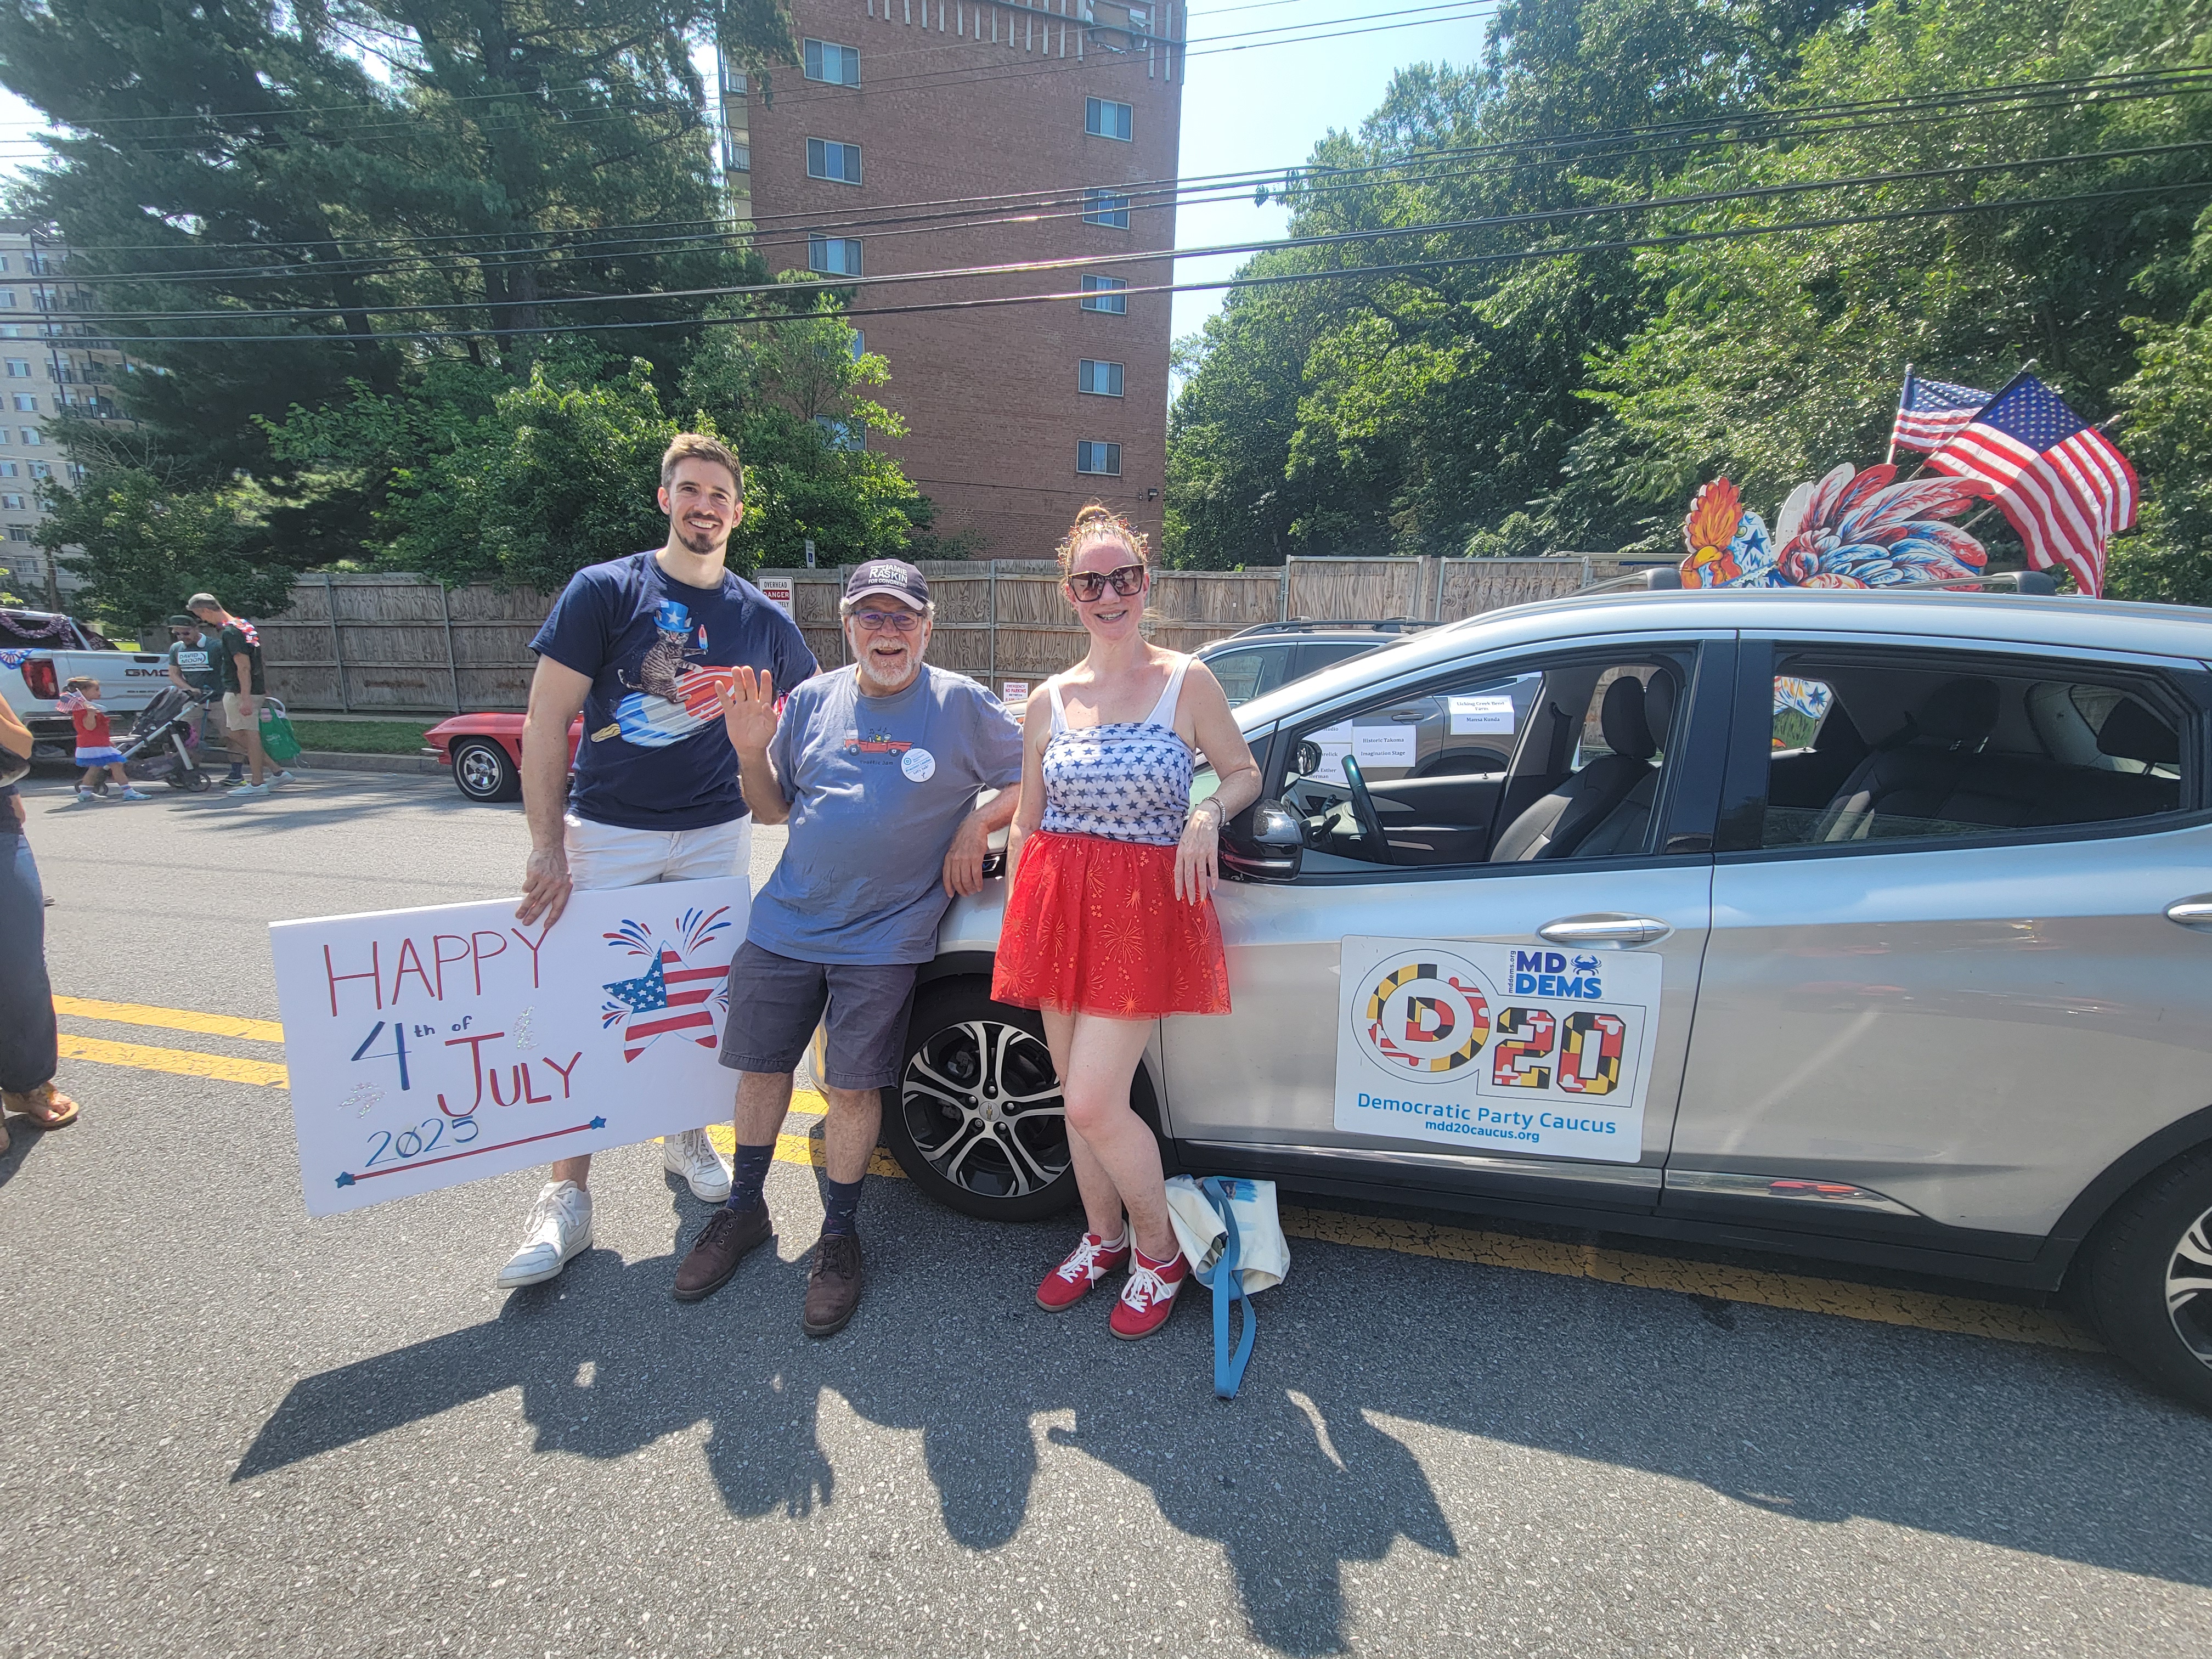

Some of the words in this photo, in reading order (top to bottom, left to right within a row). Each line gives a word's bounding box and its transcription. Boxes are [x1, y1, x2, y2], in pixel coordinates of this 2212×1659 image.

[869, 568, 908, 584] RASKIN
[878, 578, 907, 589] CONGRESS!
[882, 564, 907, 576] JAMIE
[125, 668, 169, 676] GMC
[324, 928, 549, 1017] HAPPY
[1508, 950, 1516, 994] mddems.org
[1516, 951, 1567, 974] MD
[1515, 973, 1602, 1000] DEMS
[351, 1021, 436, 1091] 4th
[452, 1015, 472, 1032] of
[1492, 1007, 1627, 1096] 20
[437, 1032, 583, 1118] JULY
[1357, 1093, 1471, 1120] Democratic
[1478, 1108, 1534, 1131] Party
[1539, 1113, 1617, 1135] Caucus
[365, 1115, 479, 1167] 2025
[1425, 1120, 1540, 1143] mdd20caucus.org
